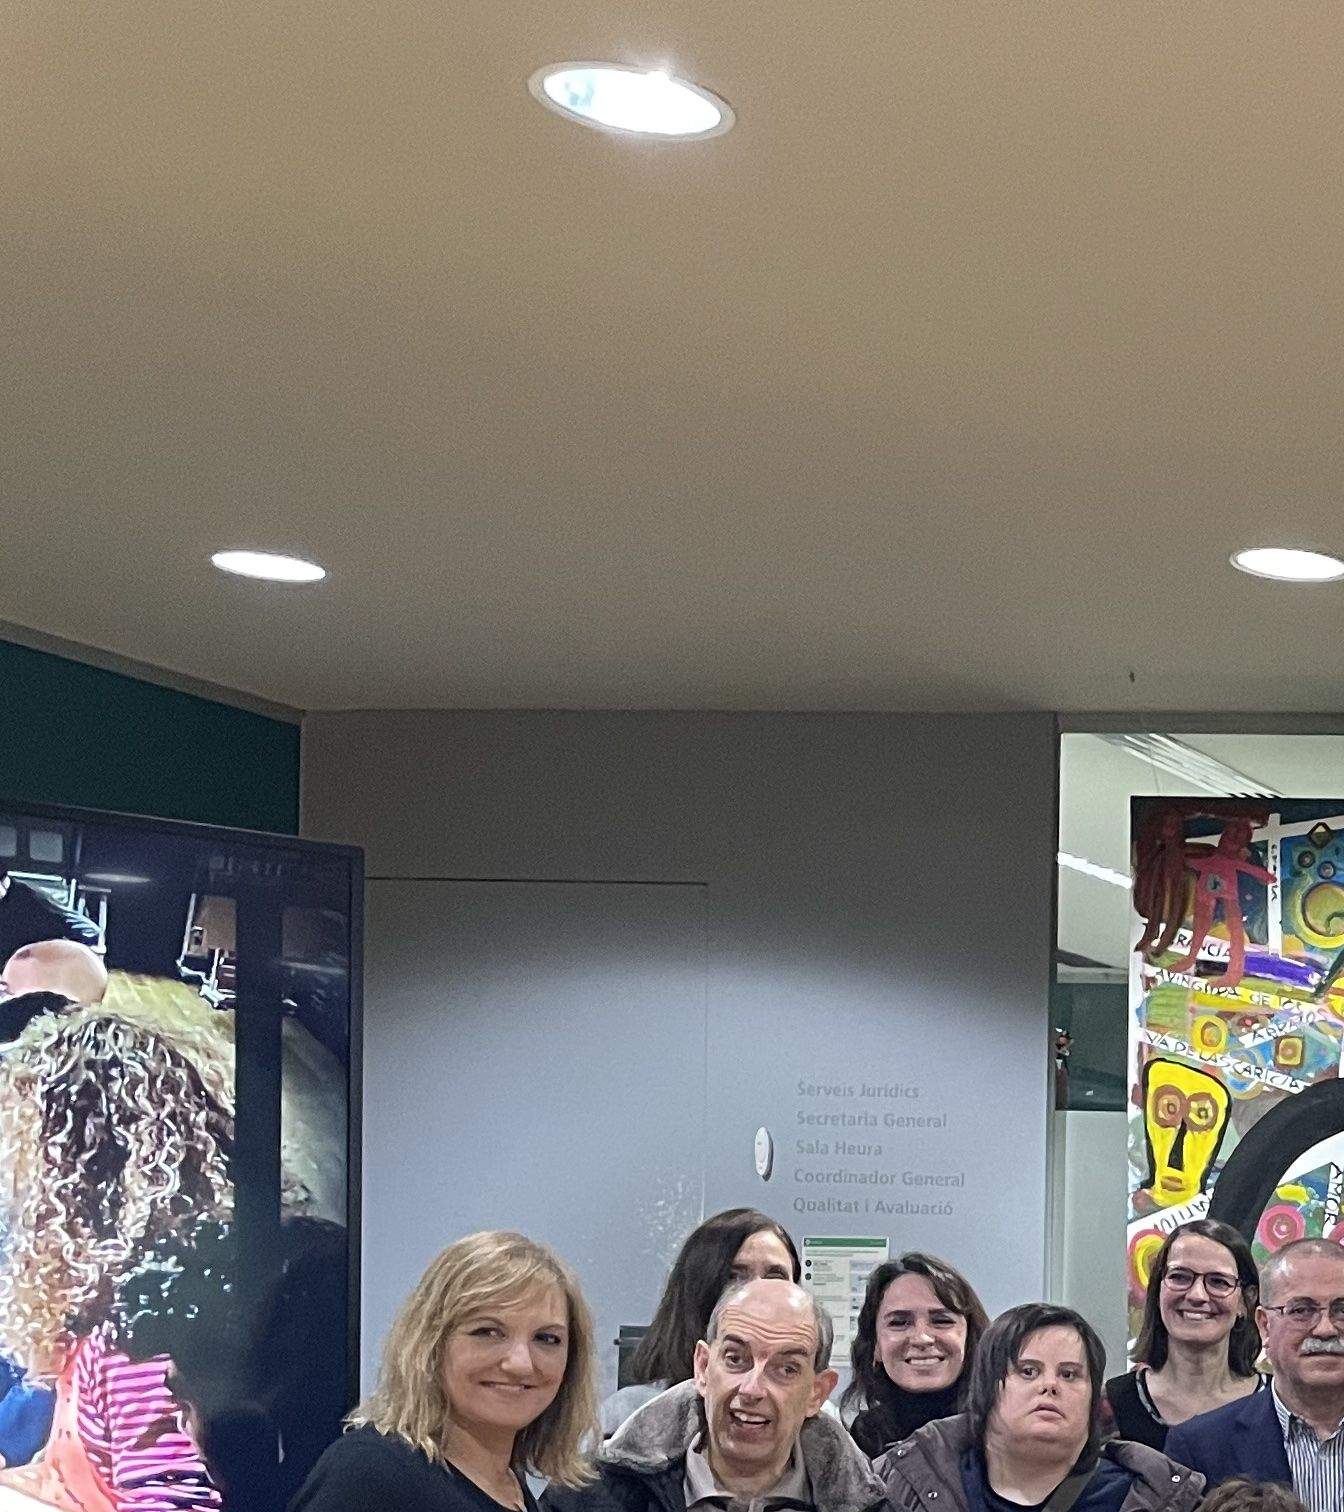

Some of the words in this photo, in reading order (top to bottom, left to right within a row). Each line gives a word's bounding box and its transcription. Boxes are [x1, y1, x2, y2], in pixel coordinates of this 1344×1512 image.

[796, 1111, 878, 1128] Secretaria
[883, 1113, 947, 1129] General
[796, 1141, 829, 1155] Sala
[794, 1168, 896, 1186] Coordinador
[902, 1171, 965, 1188] General
[793, 1197, 859, 1215] Qualitat
